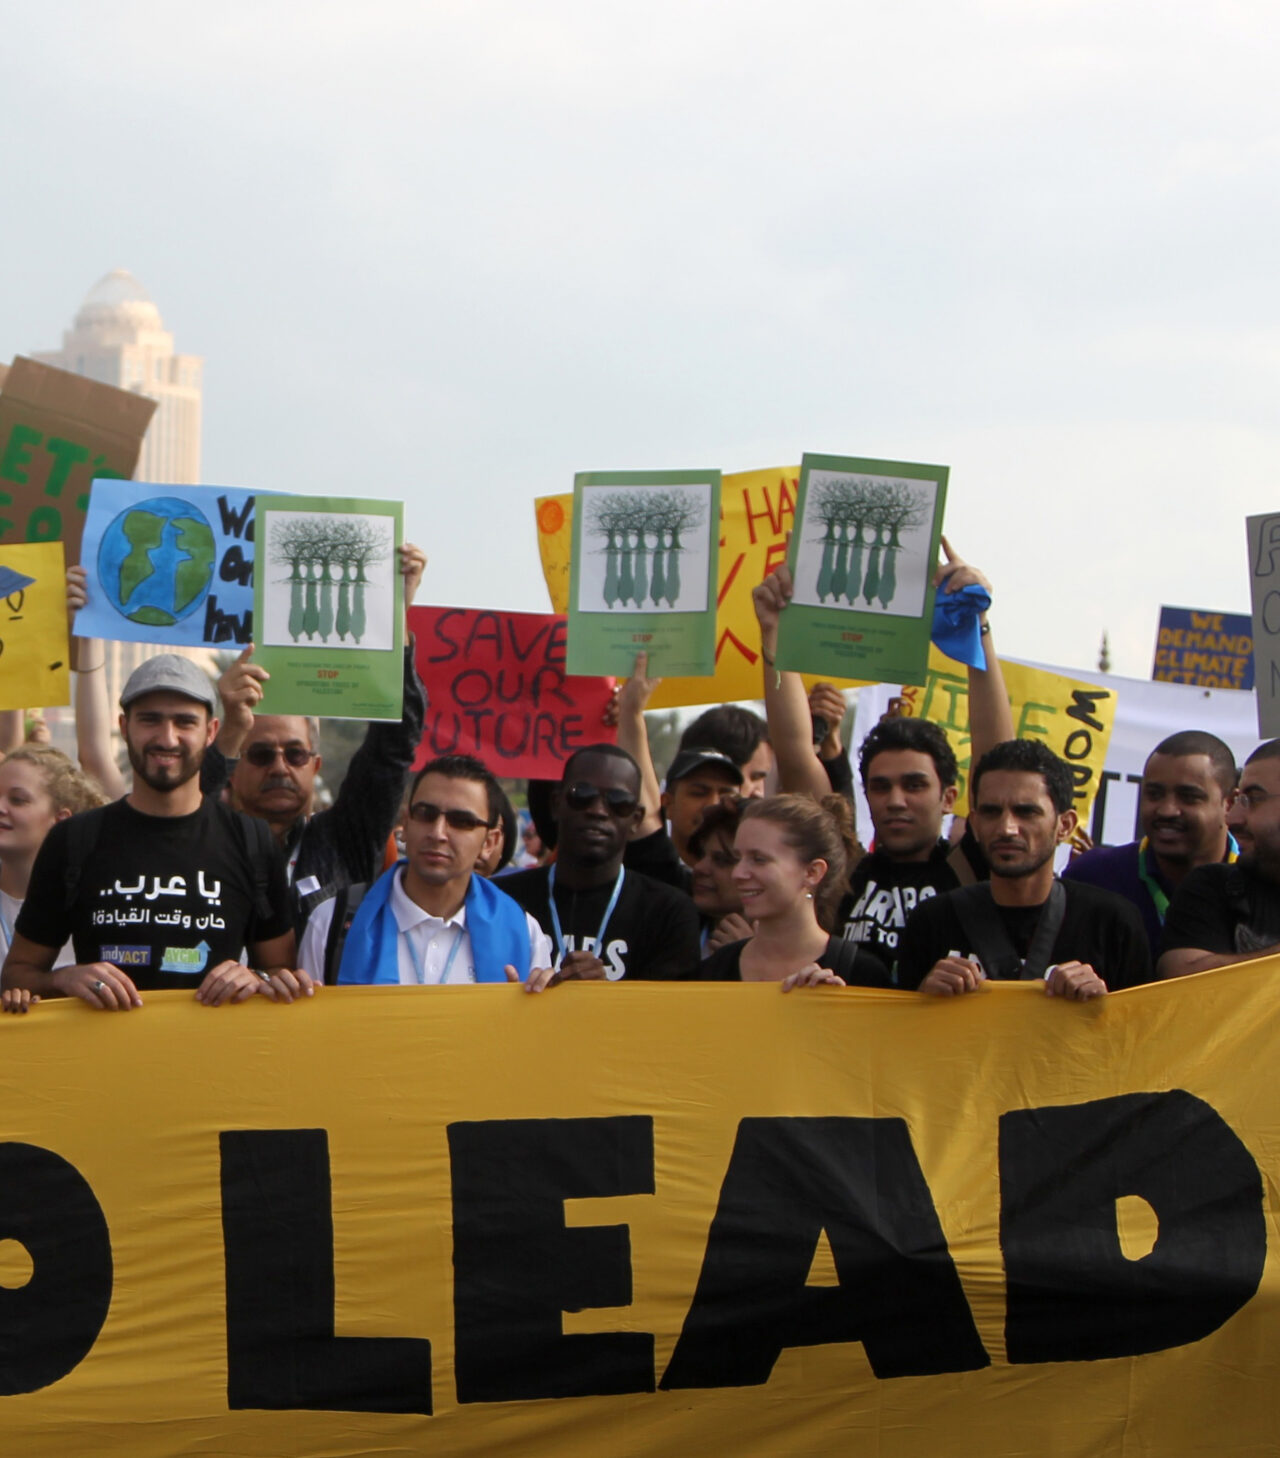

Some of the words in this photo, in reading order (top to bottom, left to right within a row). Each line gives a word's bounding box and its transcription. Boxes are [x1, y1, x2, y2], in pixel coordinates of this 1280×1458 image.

[743, 478, 799, 545] HA
[1191, 611, 1224, 632] WE
[428, 609, 567, 663] SAVE
[1159, 628, 1254, 655] DEMAND
[317, 669, 339, 679] STOP
[1156, 649, 1248, 678] CLIMATE
[451, 665, 576, 709] OUR
[430, 708, 585, 760] UTURE
[198, 870, 221, 905] يا
[154, 909, 191, 929] وقت
[196, 913, 225, 929] حان
[843, 920, 874, 942] TIME
[877, 927, 899, 948] TO
[101, 945, 148, 963] indyACT
[218, 1089, 1267, 1415] LEAD
